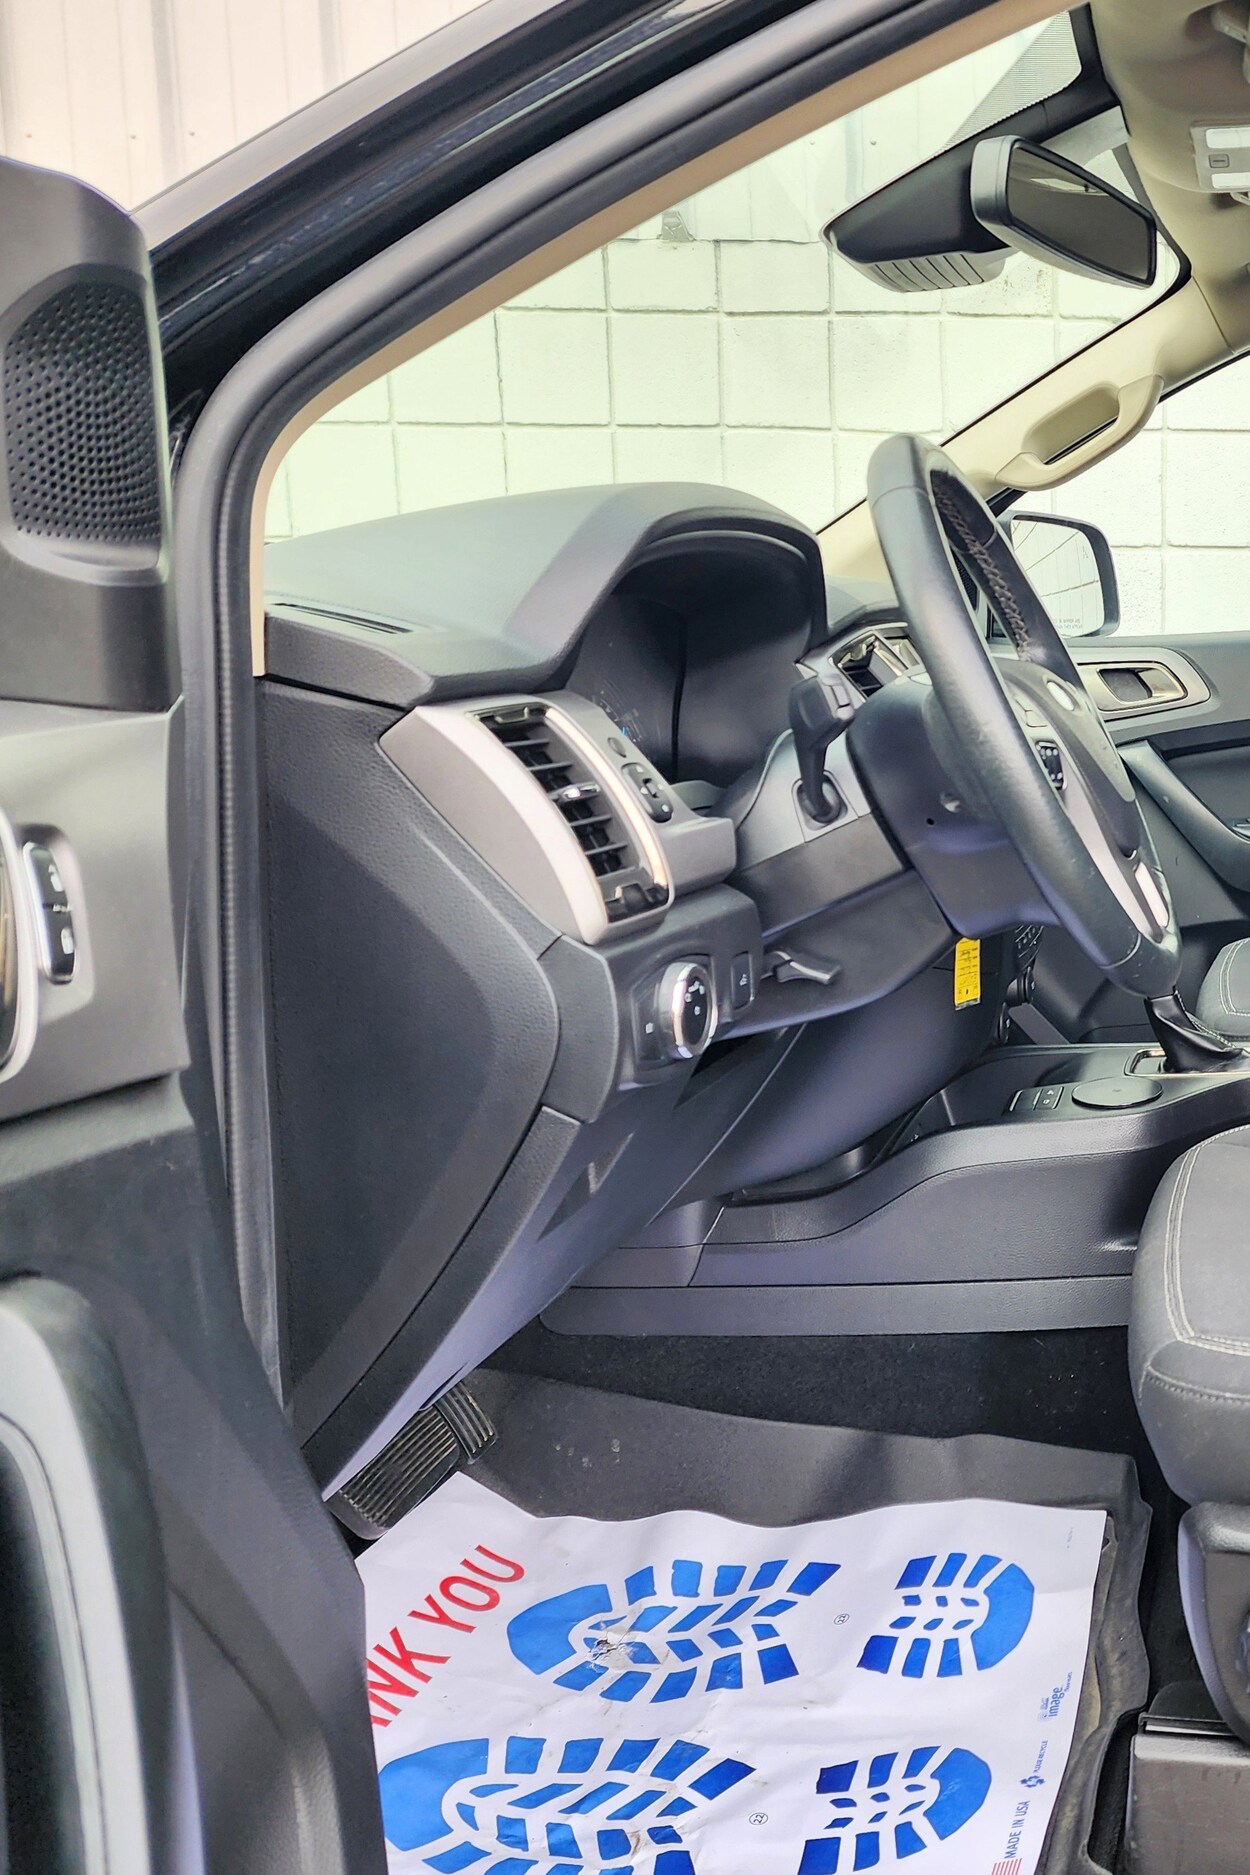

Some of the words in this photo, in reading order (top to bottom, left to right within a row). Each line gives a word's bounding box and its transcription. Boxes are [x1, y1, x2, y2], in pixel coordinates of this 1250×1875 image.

[407, 1545, 525, 1633] YOU
[1046, 1686, 1064, 1717] image
[1015, 1800, 1030, 1817] USA
[1011, 1819, 1025, 1829] IN
[1004, 1830, 1022, 1859] MADE
